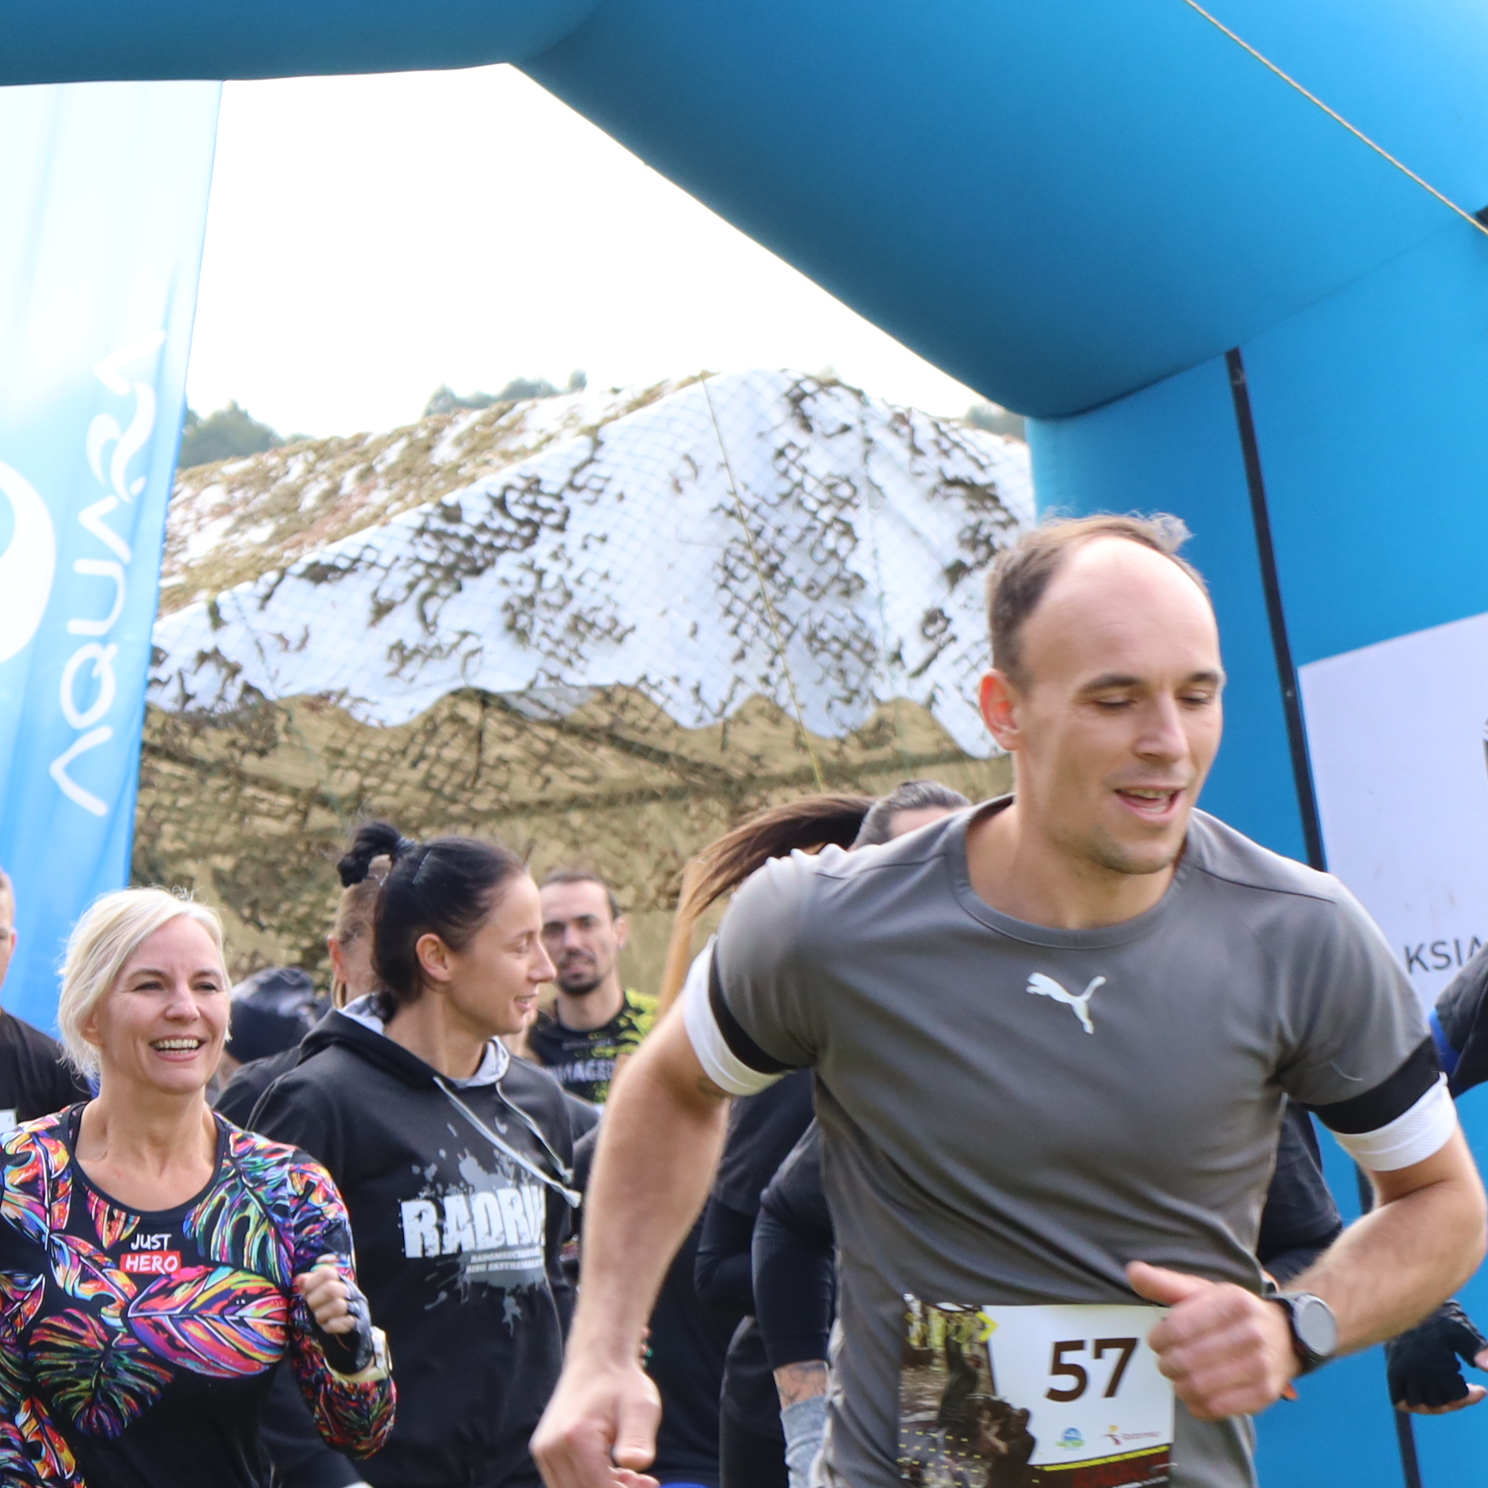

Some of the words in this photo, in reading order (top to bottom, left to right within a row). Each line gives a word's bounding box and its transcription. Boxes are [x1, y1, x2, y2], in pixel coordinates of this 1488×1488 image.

[130, 1233, 172, 1251] JUST
[125, 1254, 178, 1275] HERO
[1044, 1337, 1140, 1403] 57
